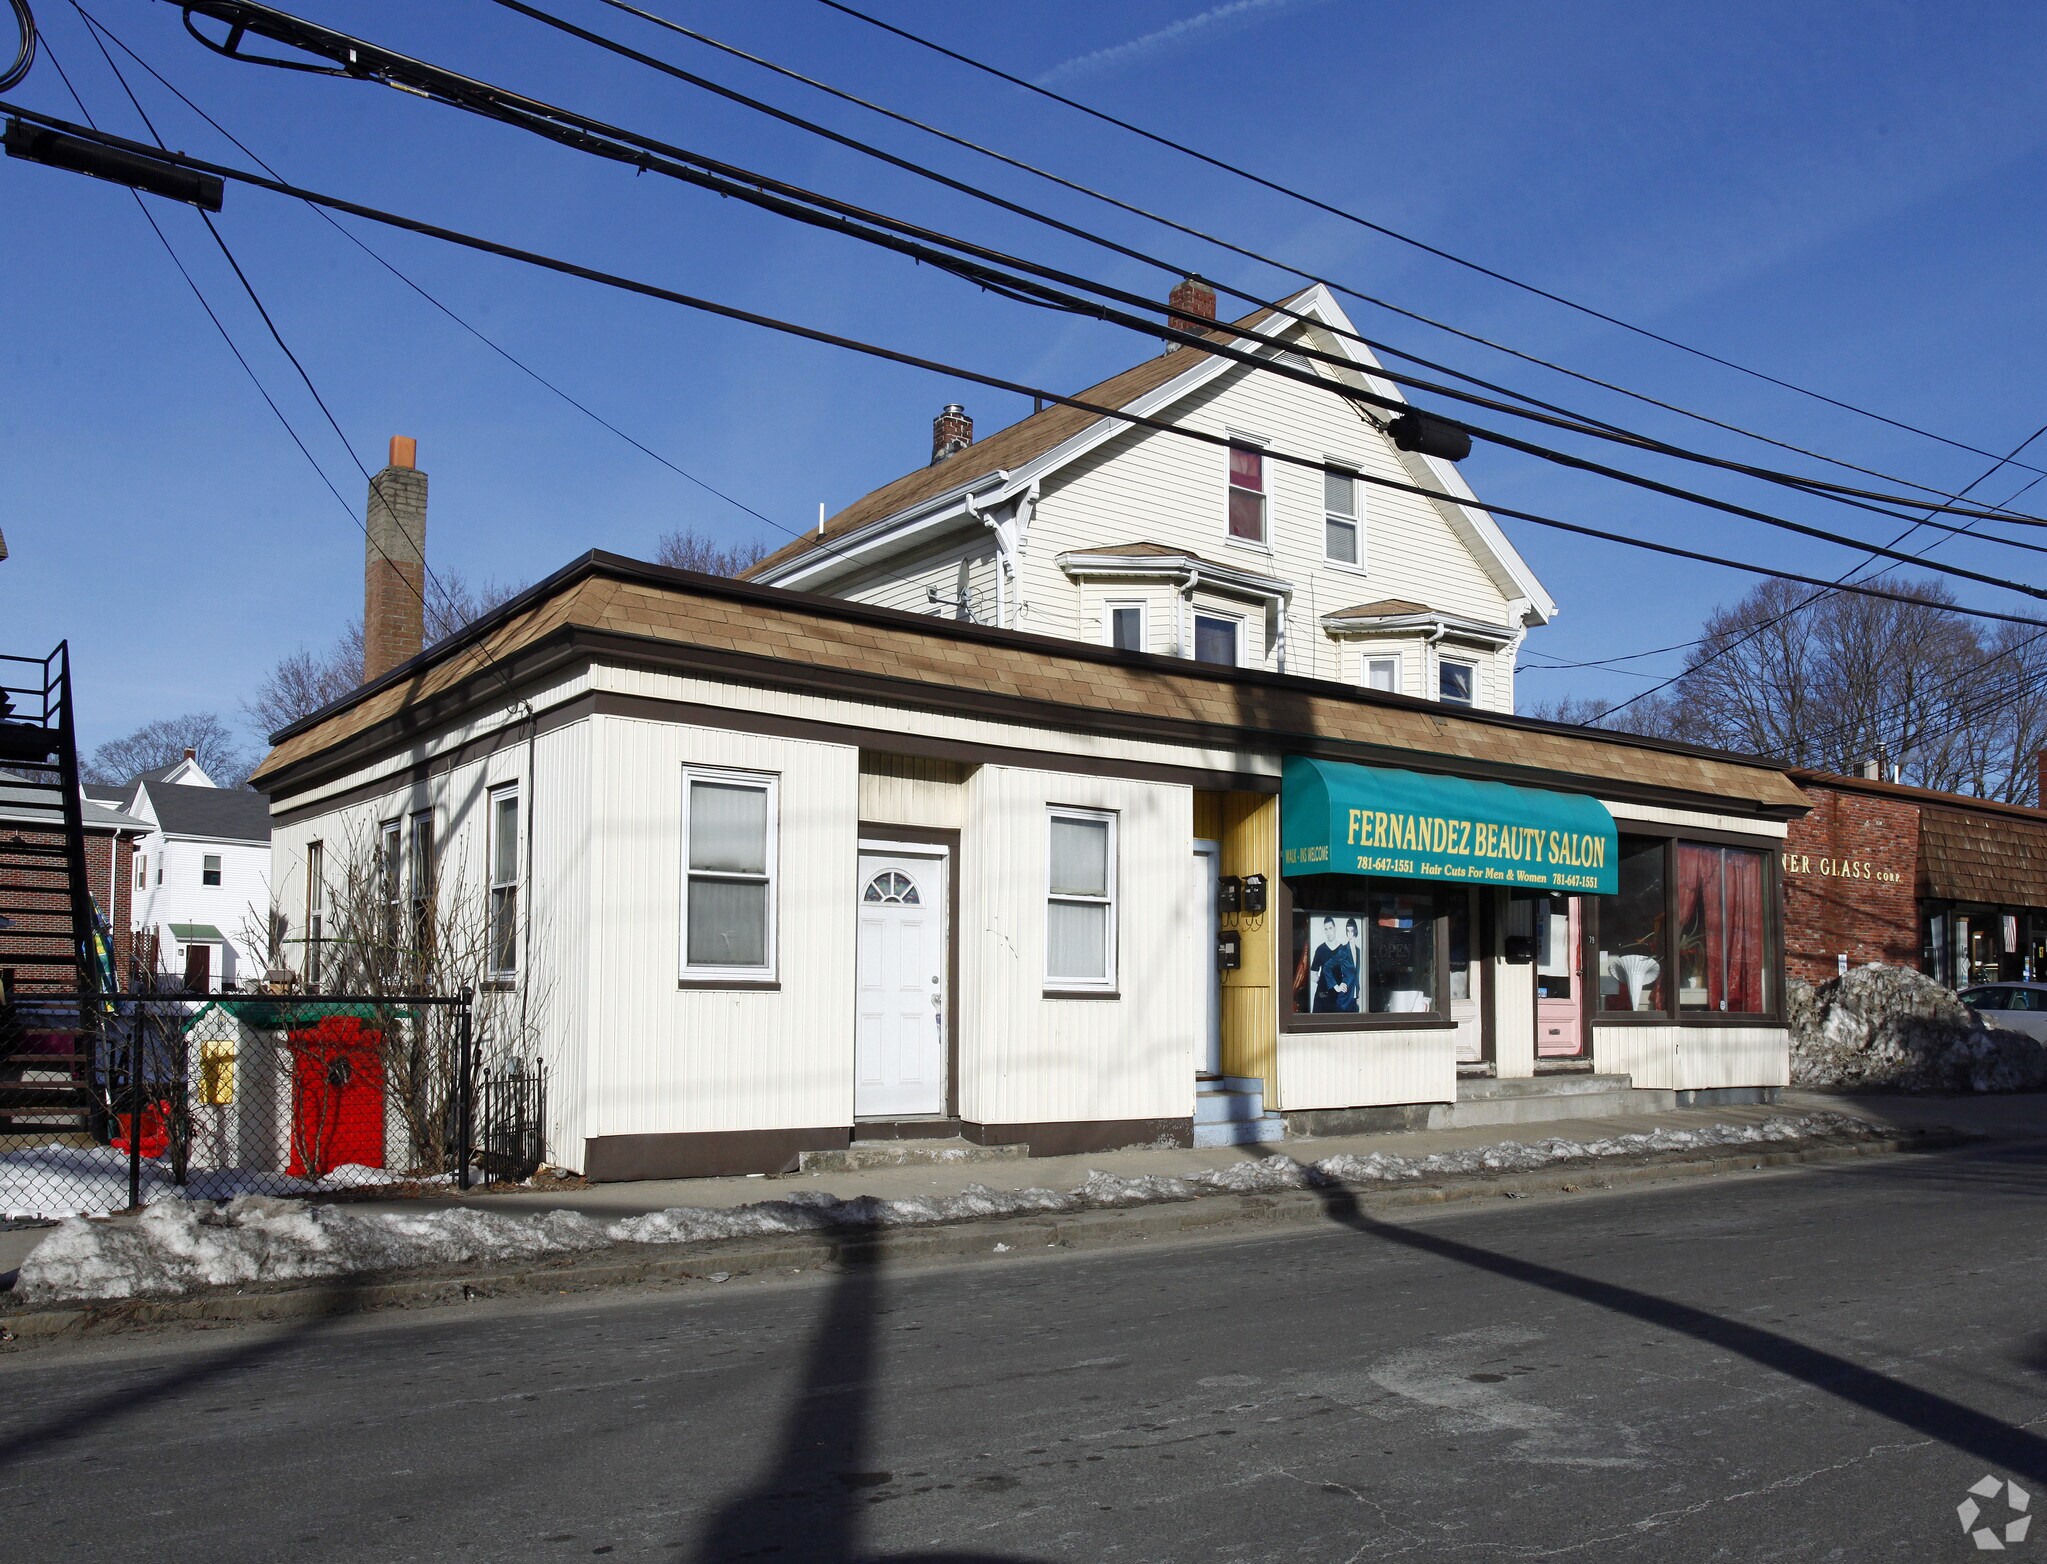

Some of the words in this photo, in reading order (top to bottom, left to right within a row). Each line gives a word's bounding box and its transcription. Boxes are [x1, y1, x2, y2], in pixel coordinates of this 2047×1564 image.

[1347, 809, 1471, 855] FERNANDEZ
[1474, 822, 1547, 861] BEAUTY
[1548, 830, 1606, 869] SALON
[1308, 845, 1328, 861] WELCOME
[1357, 856, 1414, 873] 781-647-1551
[1420, 862, 1442, 876] Hair
[1444, 863, 1466, 878] Cuts
[1468, 865, 1484, 878] For
[1485, 867, 1505, 880] Men
[1506, 868, 1515, 881] &
[1516, 870, 1547, 883] Women
[1552, 873, 1598, 888] 781-647-1551
[1820, 857, 1871, 880] GLASS
